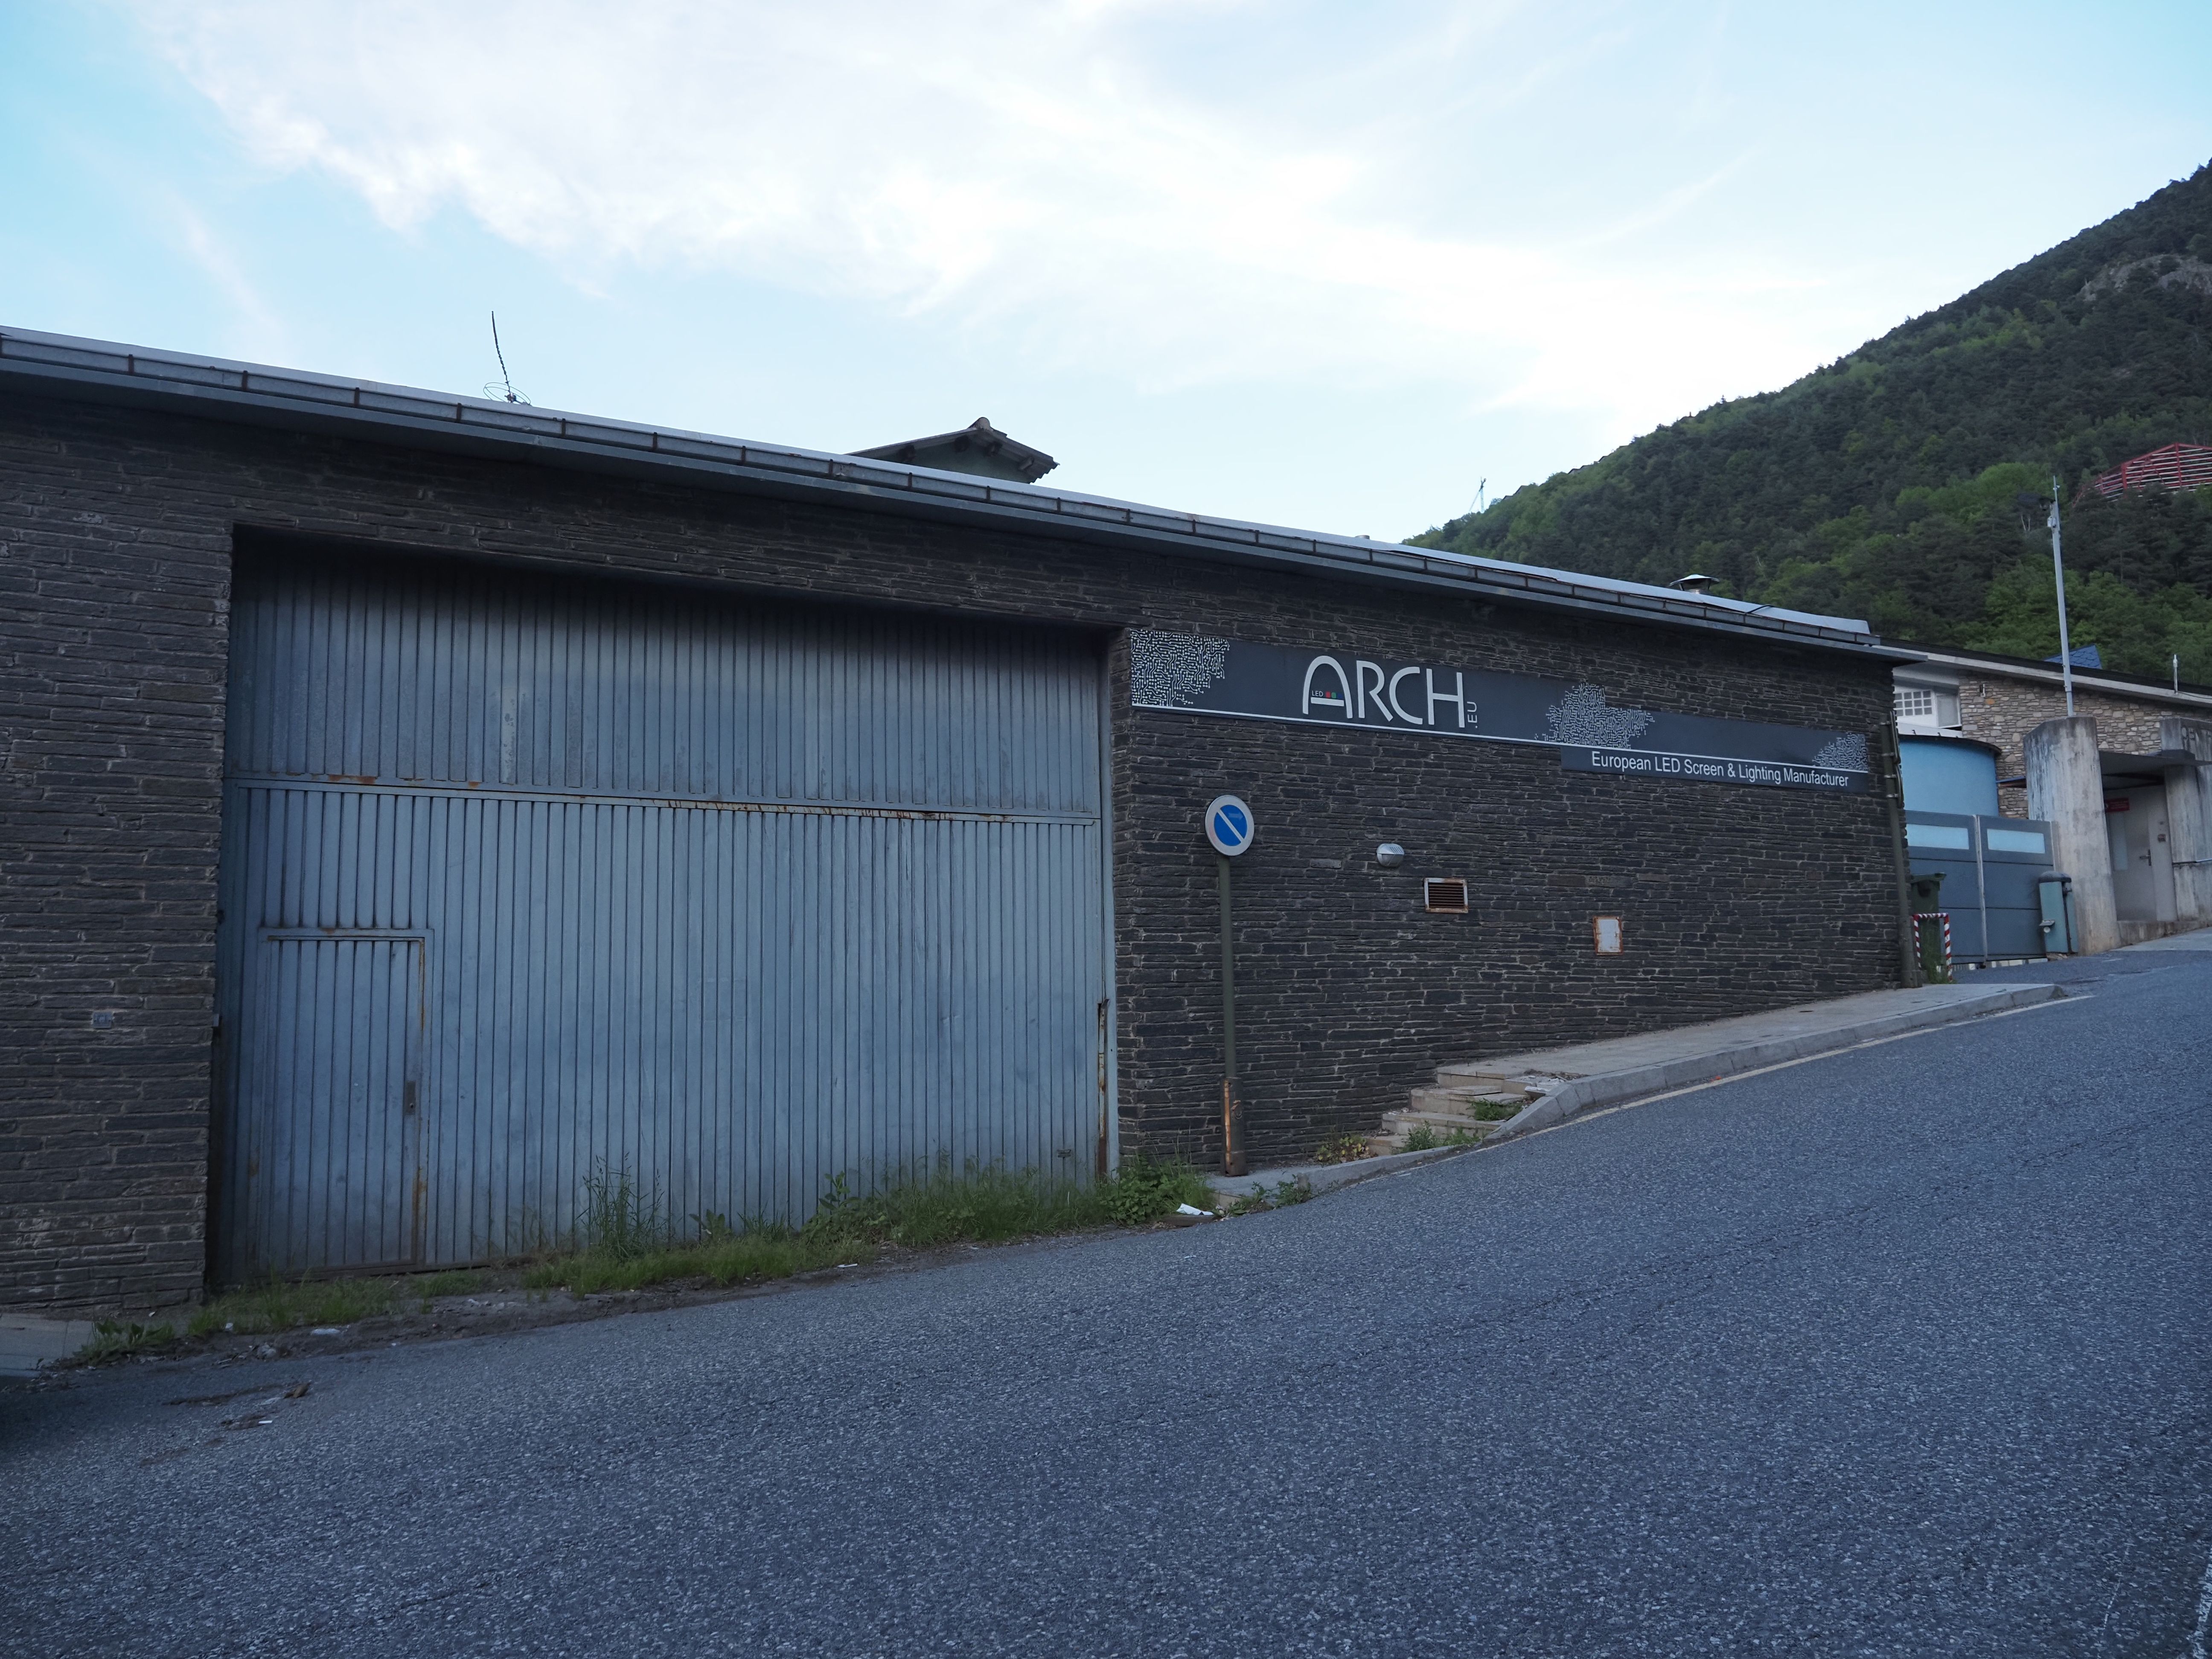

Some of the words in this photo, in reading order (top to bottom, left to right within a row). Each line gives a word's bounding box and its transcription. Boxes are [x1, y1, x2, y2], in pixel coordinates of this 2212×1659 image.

[1303, 655, 1465, 728] ARCH
[1592, 751, 1651, 772] European
[1655, 757, 1680, 773] LED
[1684, 759, 1724, 776] Screen
[1728, 763, 1736, 777] &
[1739, 764, 1781, 785] Lighting
[1784, 768, 1849, 786] Manufacturer
